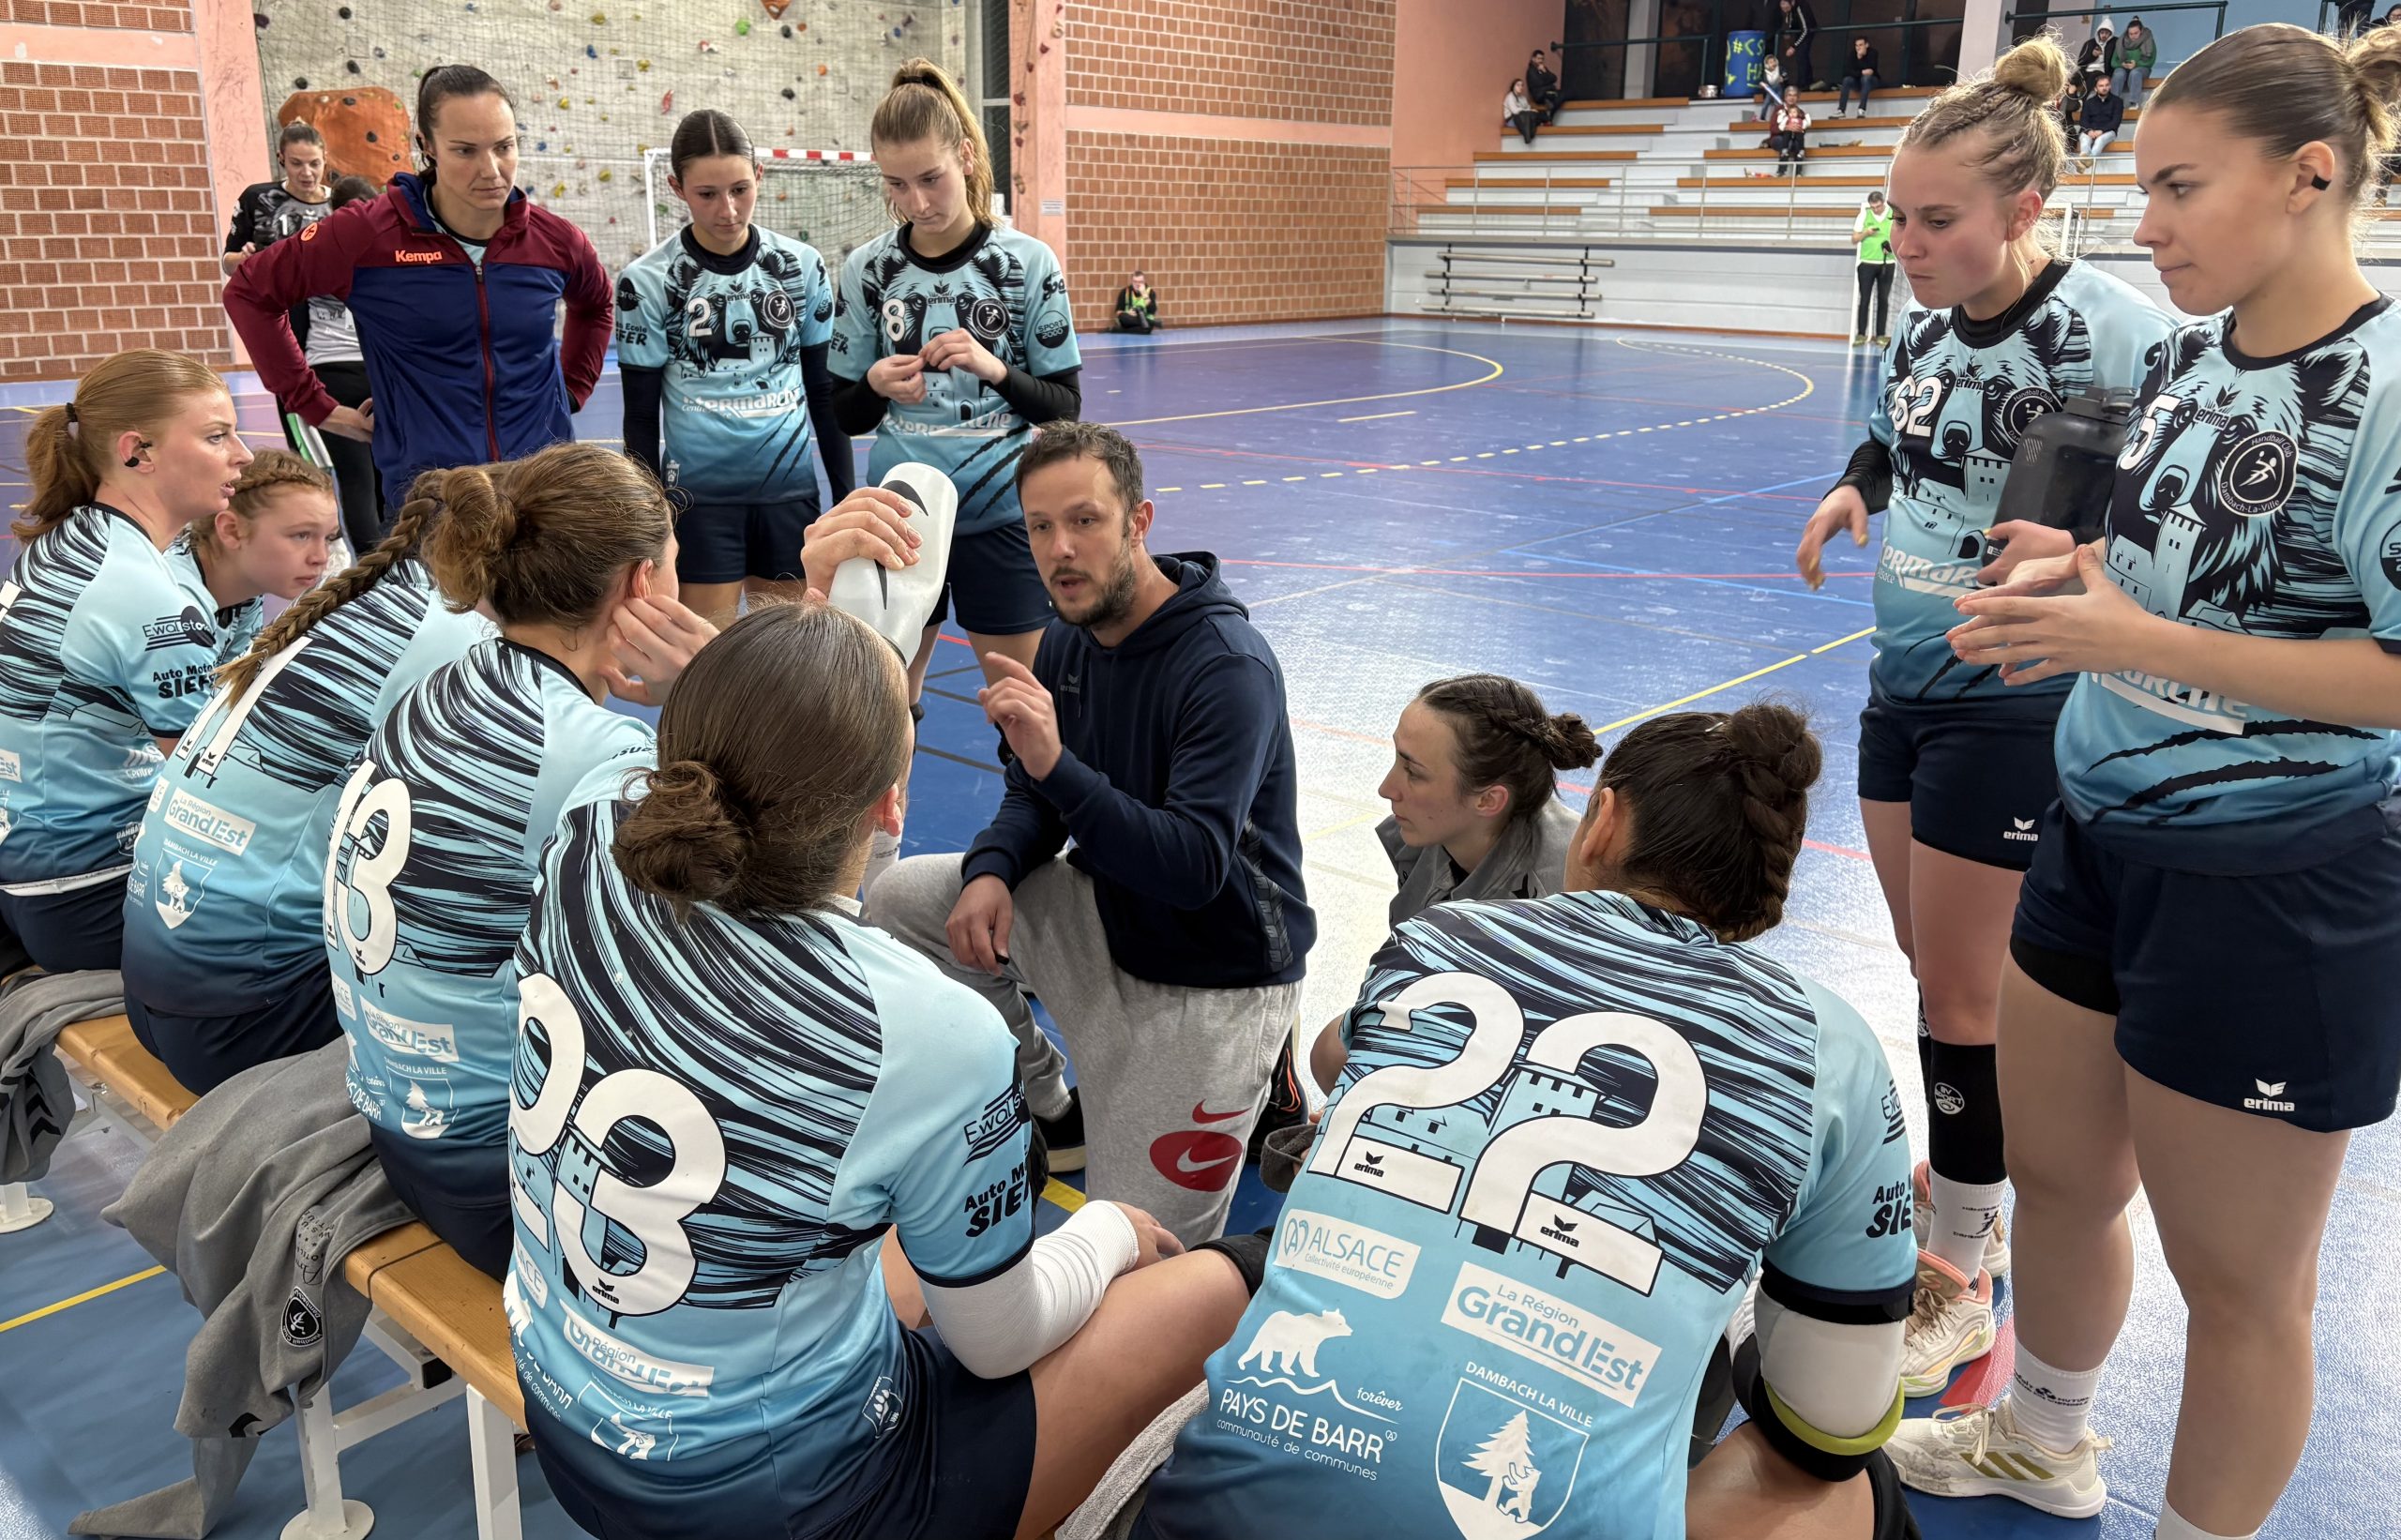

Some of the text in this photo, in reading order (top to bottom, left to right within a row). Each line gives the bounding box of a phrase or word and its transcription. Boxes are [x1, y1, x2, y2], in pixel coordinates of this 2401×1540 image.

[395, 250, 444, 264] Kempa
[927, 294, 957, 306] erima
[687, 296, 712, 338] 2
[882, 297, 906, 342] 8
[1037, 319, 1064, 333] SPORT
[1042, 326, 1064, 340] 2000
[1891, 375, 1942, 437] 62
[2013, 388, 2054, 403] Handball Club
[2195, 407, 2231, 430] erima
[2119, 393, 2182, 470] 5
[2251, 433, 2294, 458] Handball Club
[2220, 480, 2281, 514] Dambach-La-Ville
[153, 669, 183, 683] Auto
[188, 800, 212, 818] Région
[115, 825, 141, 839] DAMBA
[2003, 830, 2039, 842] erima
[189, 851, 199, 860] LA
[324, 758, 413, 976] 13
[412, 1065, 423, 1075] LA
[423, 1066, 447, 1075] VILLE
[2243, 1096, 2296, 1112] erima
[1306, 971, 1708, 1297] 22
[1353, 1164, 1384, 1178] erima
[963, 1179, 1006, 1214] Auto
[1872, 1180, 1906, 1205] Auto
[1540, 1225, 1580, 1248] erima
[1308, 1226, 1405, 1279] ALSACE
[1305, 1253, 1395, 1291] Collectivité européenne
[592, 1277, 620, 1305] erima
[1497, 1284, 1580, 1329] La Région
[592, 1336, 637, 1366] Région
[522, 1369, 534, 1383] de
[1355, 1385, 1405, 1412] forêver
[1465, 1361, 1594, 1428] DAMBACH LA VILLE
[1219, 1388, 1385, 1464] PAYS DE BARR
[1216, 1418, 1379, 1482] communauté de communes
